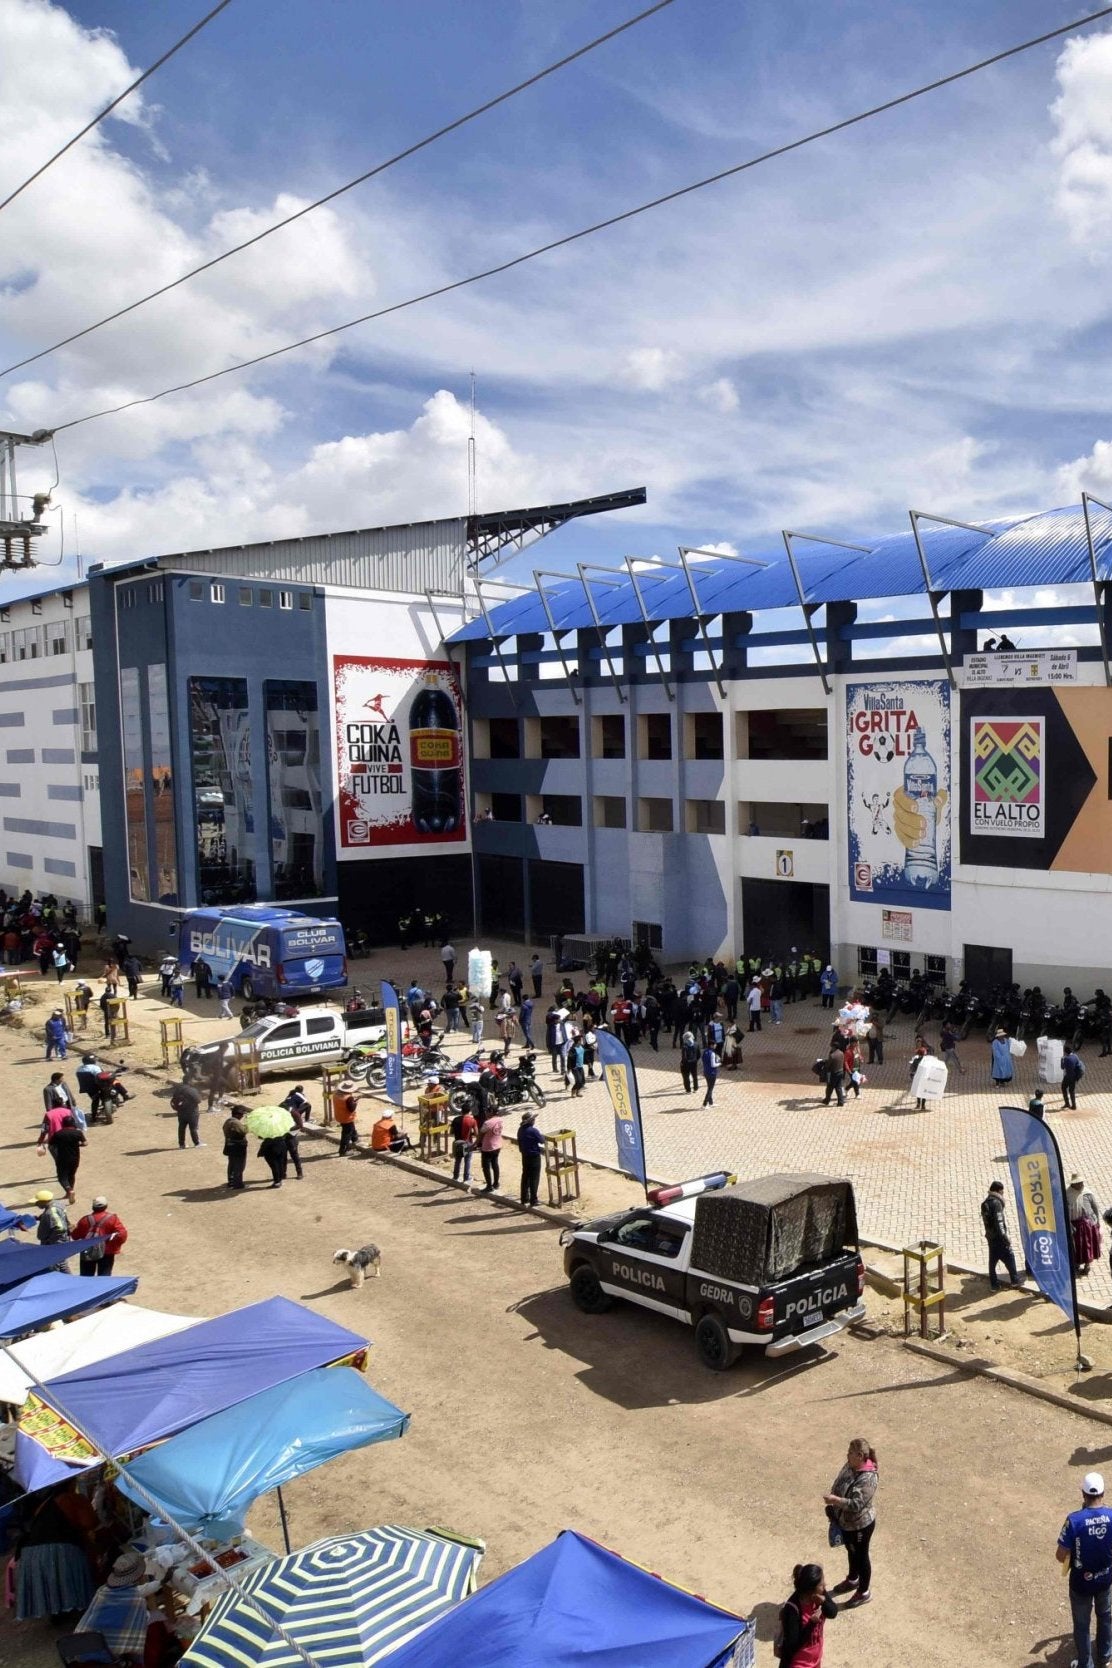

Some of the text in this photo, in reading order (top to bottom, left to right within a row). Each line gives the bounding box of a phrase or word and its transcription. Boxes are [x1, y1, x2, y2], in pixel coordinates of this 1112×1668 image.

[864, 693, 903, 711] VillaSanta
[347, 723, 401, 745] COKA
[349, 744, 402, 763] QUINA
[367, 764, 387, 773] VIVE
[352, 775, 407, 794] FUTBOL
[975, 803, 1040, 821] EL ALTO
[991, 819, 1013, 827] VUELO
[1015, 820, 1040, 828] PROPIO
[782, 857, 787, 873] 1
[288, 935, 336, 947] BOLIVAR
[297, 929, 327, 938] CLUB
[190, 930, 271, 968] BOLIVAR
[260, 1041, 340, 1060] POLICIA BOLIVIANA
[612, 1261, 666, 1293] POLICIA
[700, 1283, 734, 1305] GEDRA
[785, 1283, 848, 1319] POLICIA
[1085, 1515, 1110, 1526] PACEÑA
